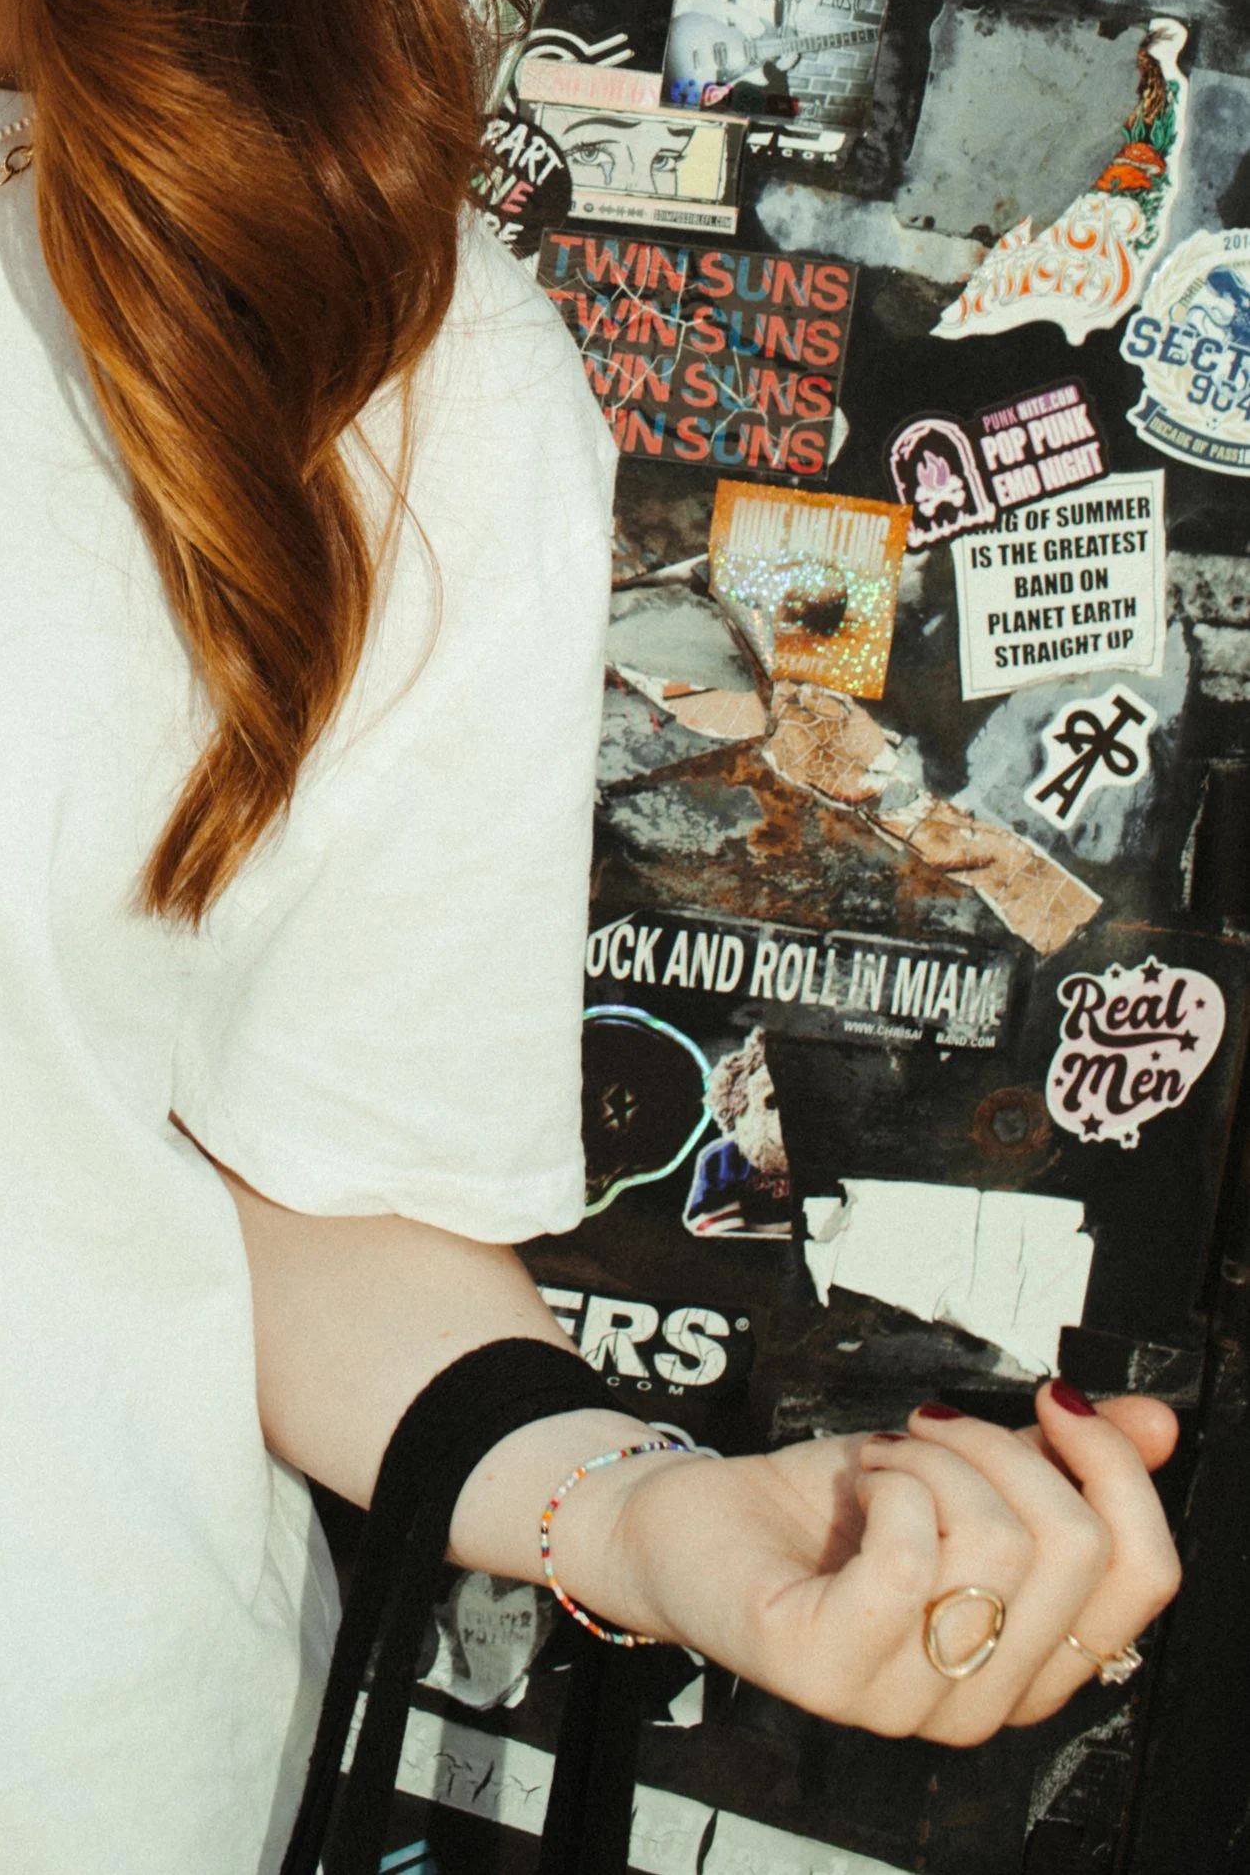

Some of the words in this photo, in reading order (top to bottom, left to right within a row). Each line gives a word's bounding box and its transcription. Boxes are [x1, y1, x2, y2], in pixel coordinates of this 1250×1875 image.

[550, 234, 688, 293] TWIN
[696, 251, 851, 312] SUNS
[550, 288, 680, 349] TWIN
[690, 306, 843, 366] SUNS
[681, 361, 834, 420] SUNS
[673, 417, 826, 475] SUNS
[979, 426, 1028, 472] POP
[1026, 403, 1097, 456] PUNK
[1193, 437, 1208, 455] OF
[990, 463, 1043, 508] EMO
[1037, 441, 1104, 493] NIGHT
[1025, 507, 1051, 531] OF
[1055, 496, 1151, 528] SUMMER
[971, 546, 993, 569] IS
[997, 542, 1038, 566] THE
[1043, 529, 1149, 562] GREATEST
[1014, 570, 1074, 600] BAND
[1079, 567, 1110, 593] ON
[987, 604, 1066, 636] PLANET
[1070, 597, 1138, 627] EARTH
[994, 636, 1102, 668] STRAIGHT
[1106, 628, 1135, 651] UP
[661, 928, 746, 994] AND
[749, 940, 839, 1008] ROLL
[849, 950, 888, 1012] IN
[1060, 976, 1188, 1037] Real
[1062, 1051, 1186, 1117] Men
